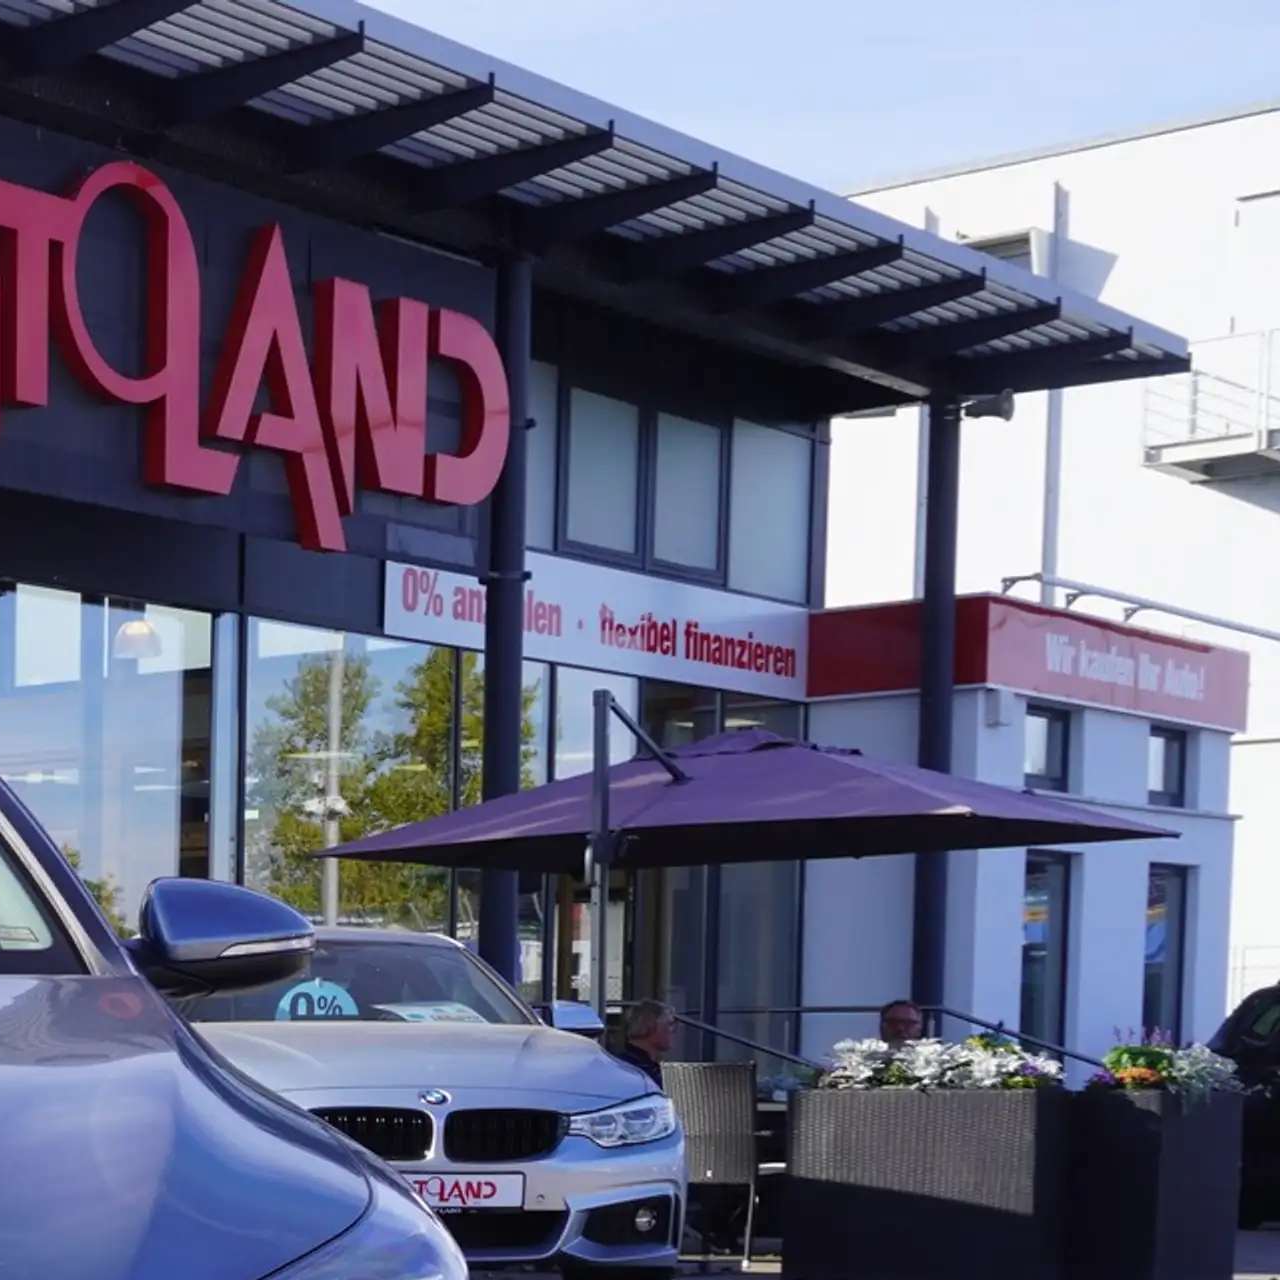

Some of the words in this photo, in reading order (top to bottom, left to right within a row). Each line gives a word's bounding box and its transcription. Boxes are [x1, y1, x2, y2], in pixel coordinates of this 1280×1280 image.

[402, 567, 444, 617] 0%
[452, 585, 562, 638] anlen
[599, 602, 677, 658] flexibel
[684, 622, 797, 679] finanzieren
[412, 1175, 498, 1205] TOLAND
